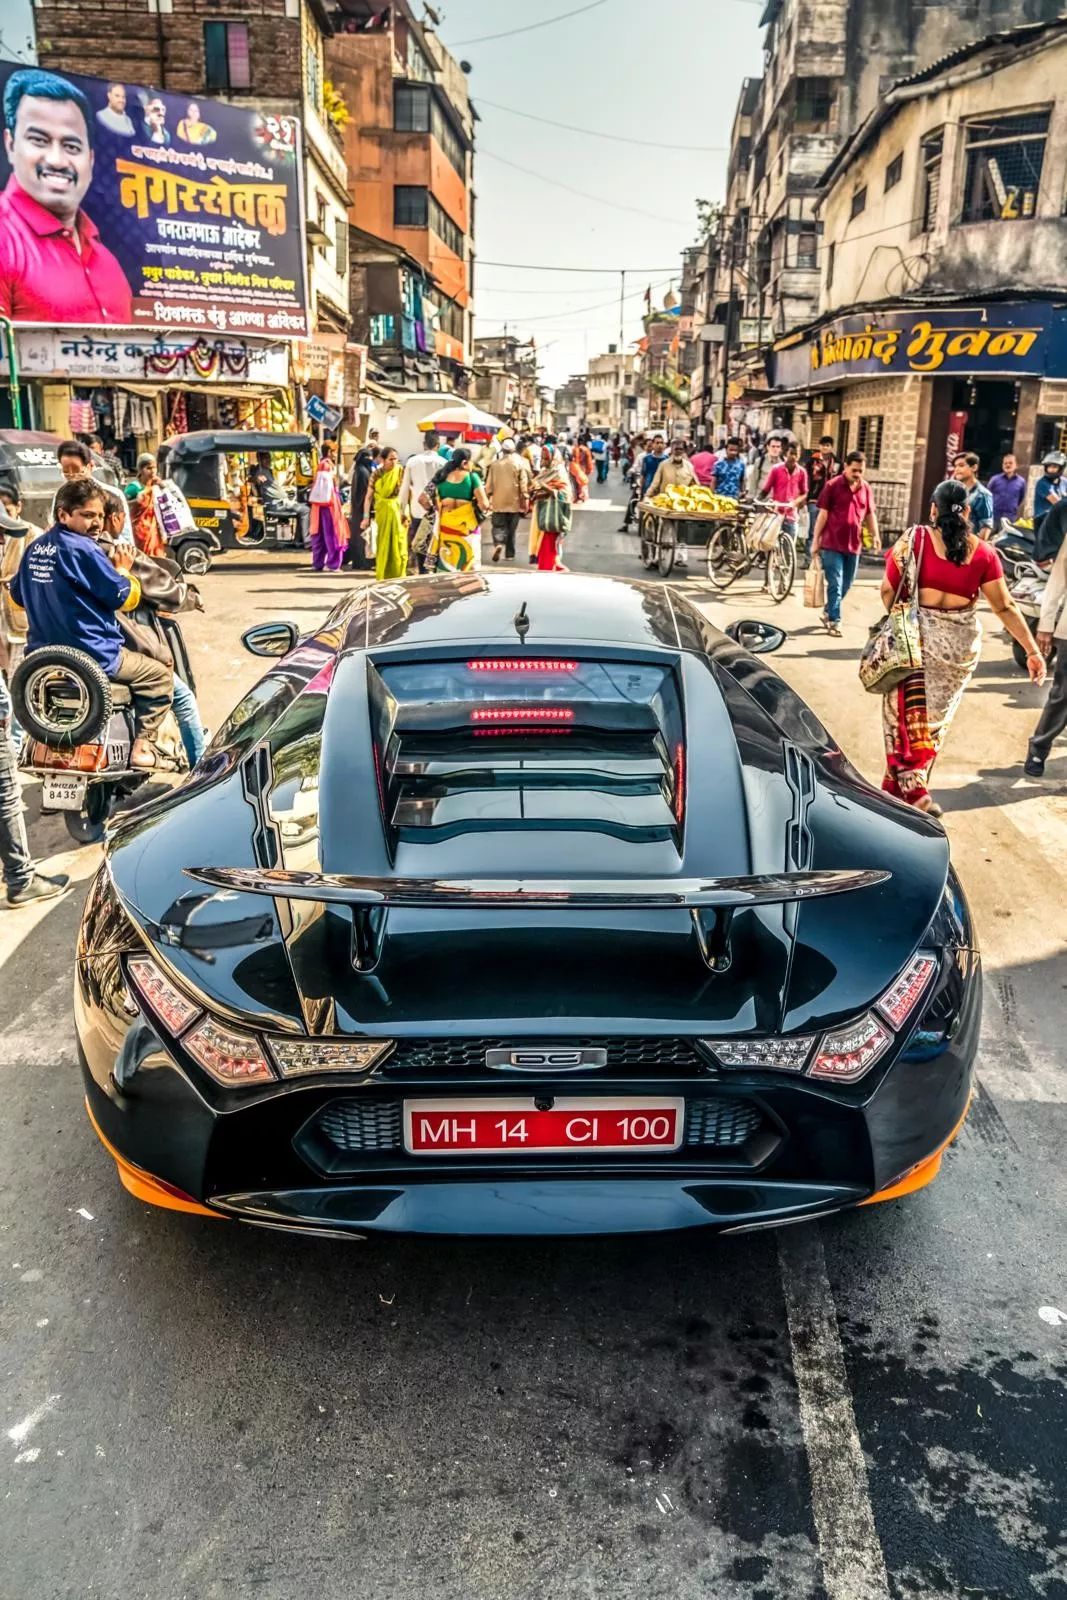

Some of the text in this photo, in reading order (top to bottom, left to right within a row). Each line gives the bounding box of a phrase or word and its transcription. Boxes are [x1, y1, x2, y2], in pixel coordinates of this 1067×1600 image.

[116, 158, 287, 236] नगरसेवक
[61, 334, 121, 362] नरेन्द्र
[907, 321, 1044, 370] भुवन
[49, 790, 77, 800] 8435
[420, 1116, 670, 1142] MH 14 CI 100
